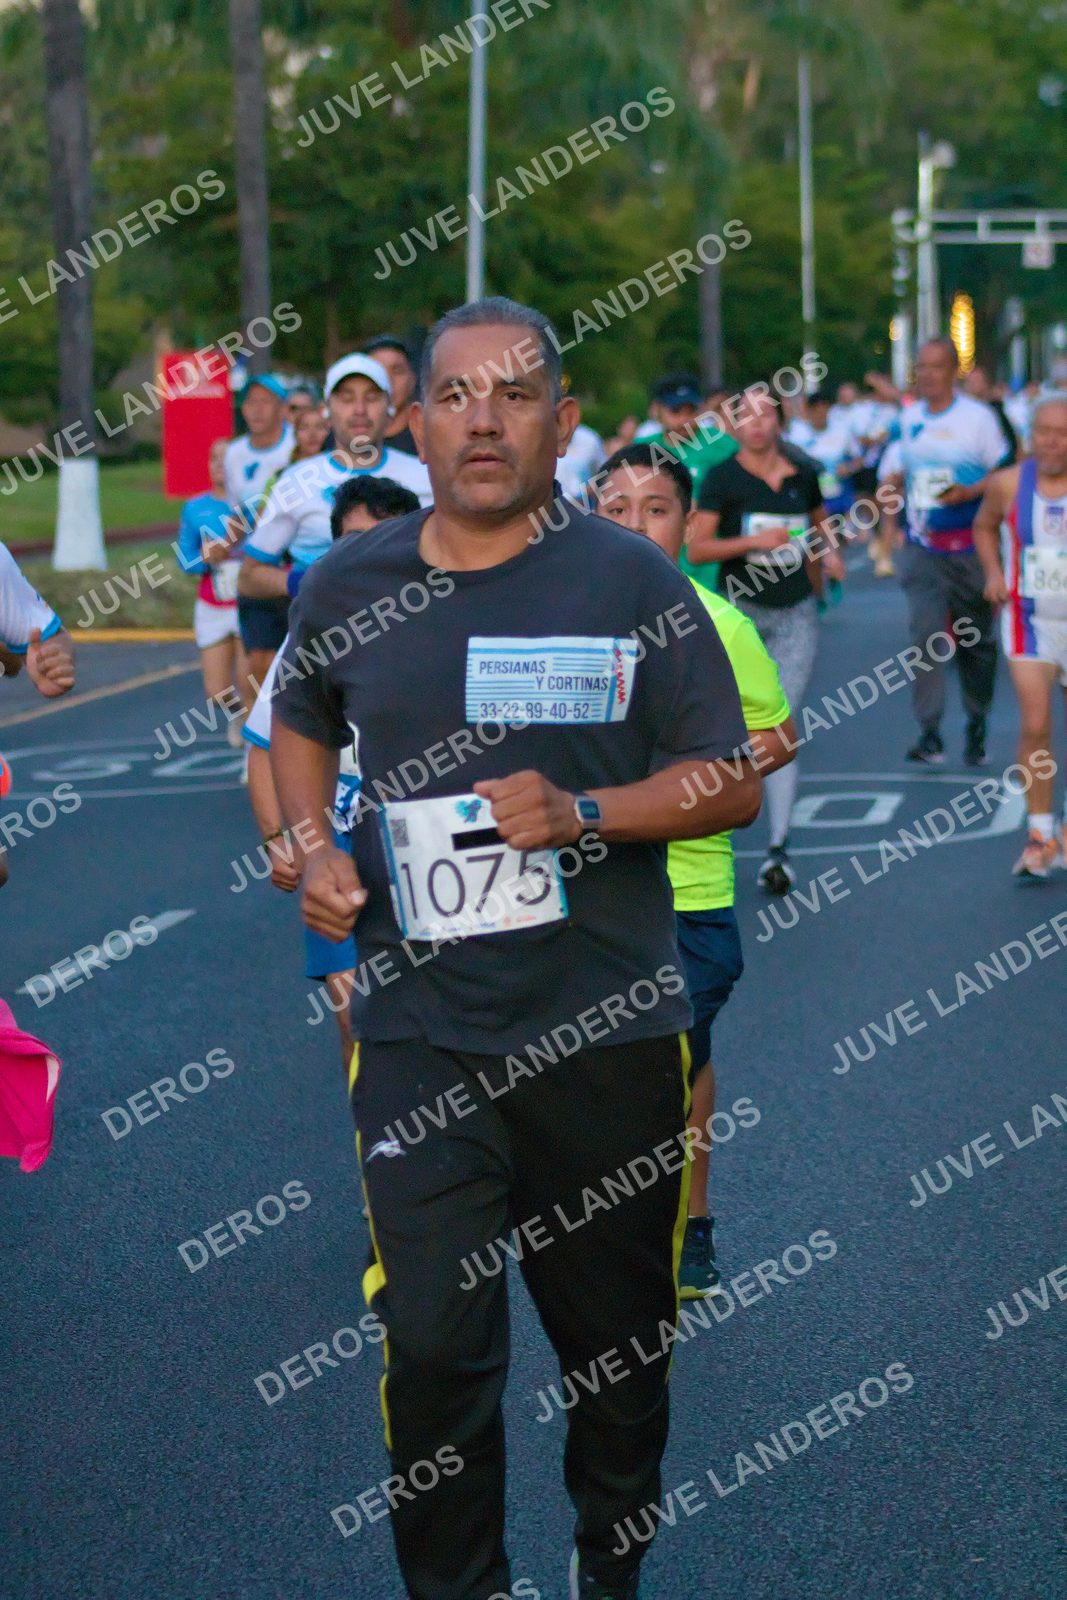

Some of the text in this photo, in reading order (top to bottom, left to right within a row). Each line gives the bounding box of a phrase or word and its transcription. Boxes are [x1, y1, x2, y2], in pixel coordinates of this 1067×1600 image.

[479, 660, 546, 675] PERSIANAS
[536, 676, 608, 691] Y CORTINAS
[480, 702, 590, 719] 33-22-89-40-52
[401, 849, 552, 919] 1075
